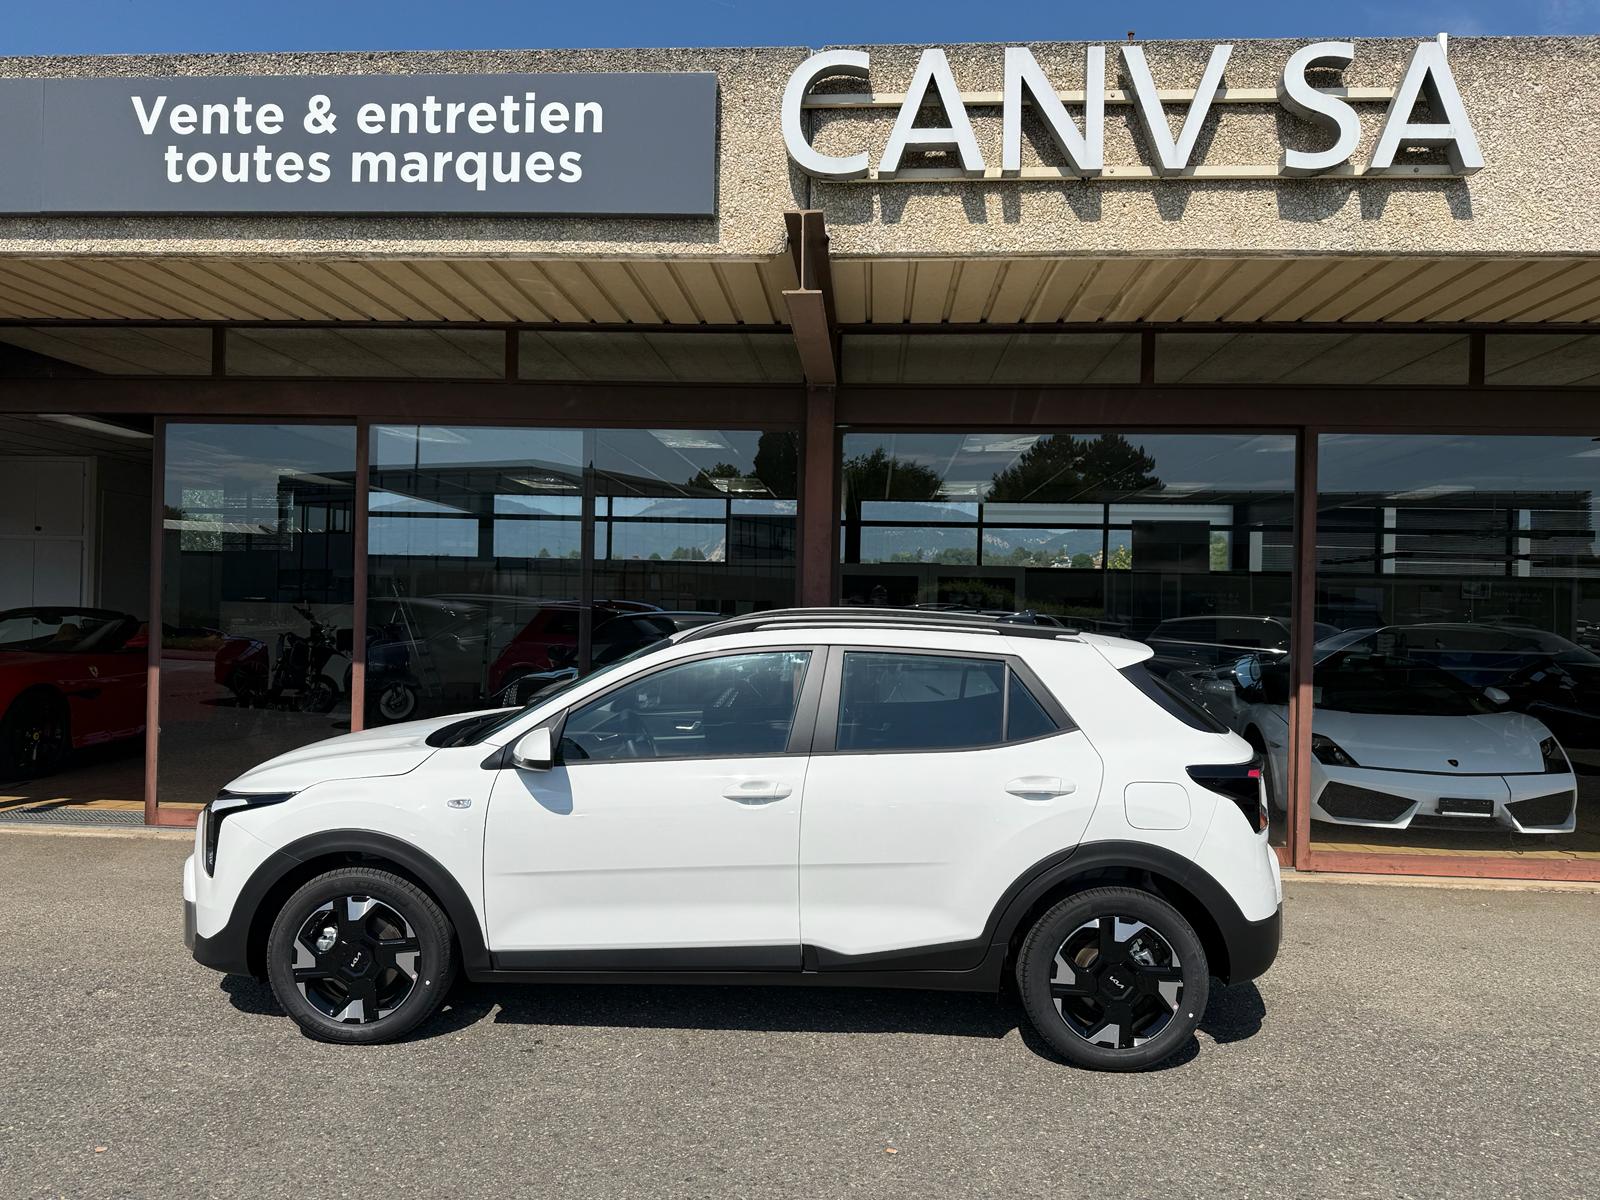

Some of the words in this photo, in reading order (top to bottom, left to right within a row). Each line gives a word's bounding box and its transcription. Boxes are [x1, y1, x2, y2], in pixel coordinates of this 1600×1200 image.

[130, 94, 286, 136] Vente
[302, 94, 338, 135] &
[355, 91, 604, 135] entretien
[781, 45, 1235, 178] CANV
[1279, 40, 1485, 176] SA
[164, 144, 332, 184] toutes
[350, 150, 584, 191] marques
